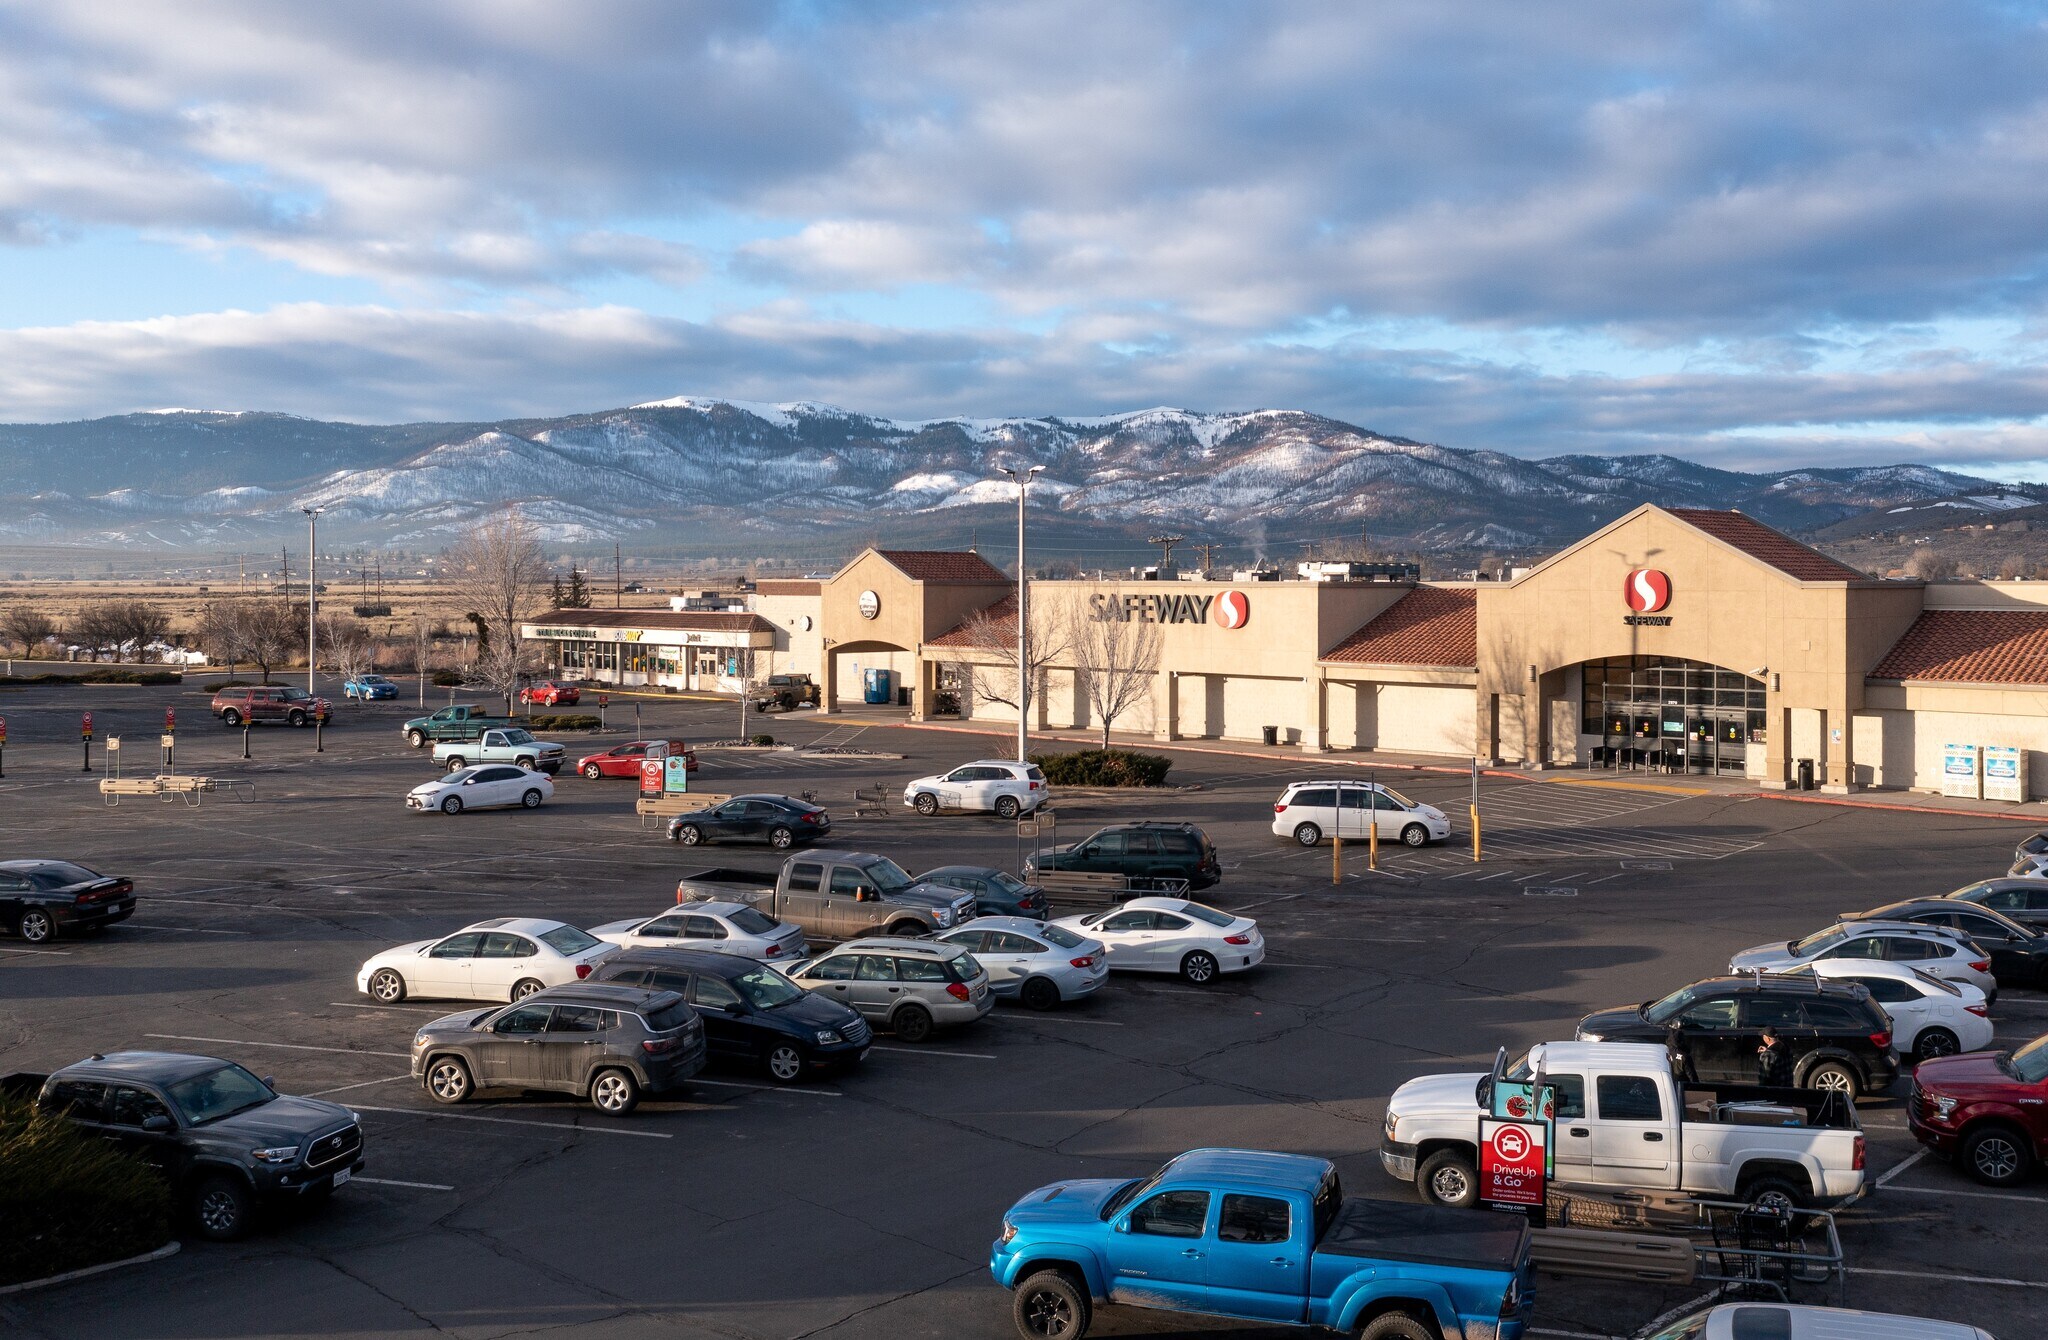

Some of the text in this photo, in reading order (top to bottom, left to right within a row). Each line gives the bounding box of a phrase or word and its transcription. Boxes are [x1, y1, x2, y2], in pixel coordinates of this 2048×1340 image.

[1088, 593, 1214, 624] SAFEWAY
[1623, 616, 1673, 626] SAFEWAY
[1493, 1163, 1537, 1179] DriveUp
[1493, 1175, 1502, 1185] &
[1492, 1203, 1527, 1211] safeway.com
